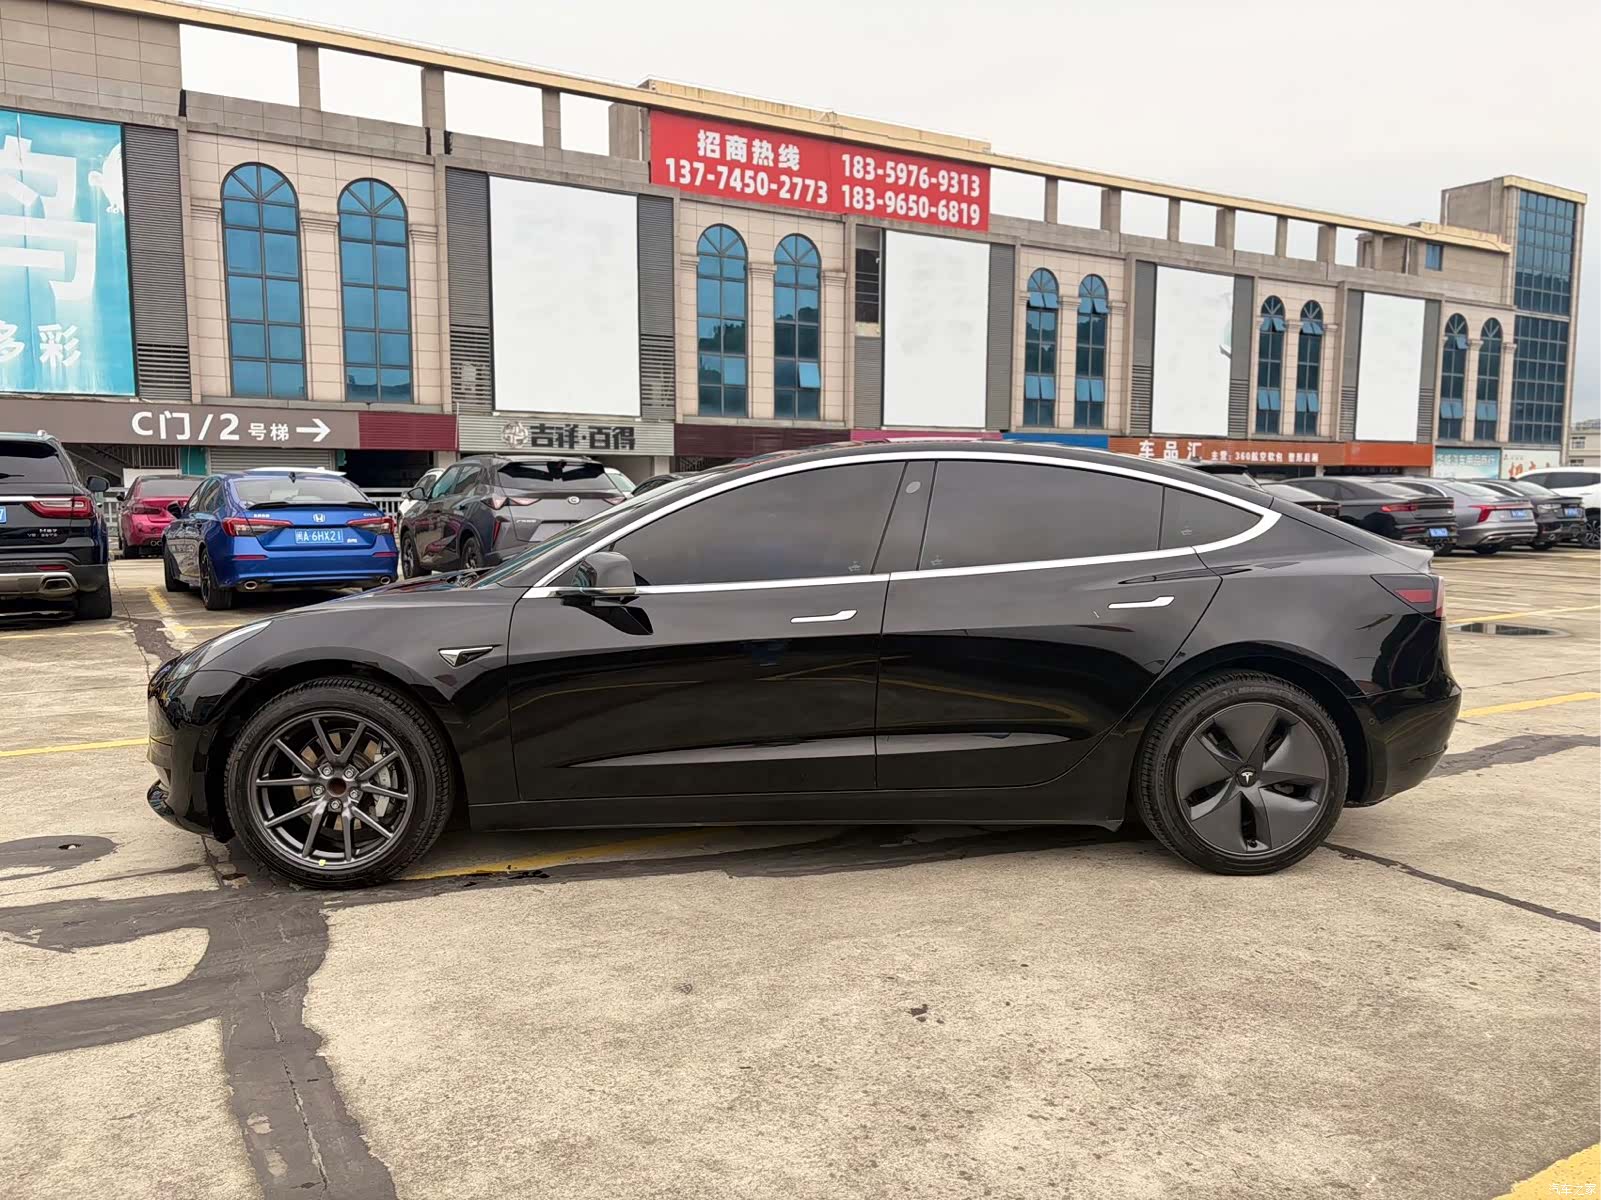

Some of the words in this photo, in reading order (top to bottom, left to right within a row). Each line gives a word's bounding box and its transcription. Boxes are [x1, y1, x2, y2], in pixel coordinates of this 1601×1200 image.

[697, 129, 800, 171] 招商热线
[665, 157, 828, 204] 137-7450-2773
[841, 153, 980, 198] 183-5976-9313
[841, 184, 980, 226] 183-9650-6819
[1139, 440, 1202, 460] 车品汇
